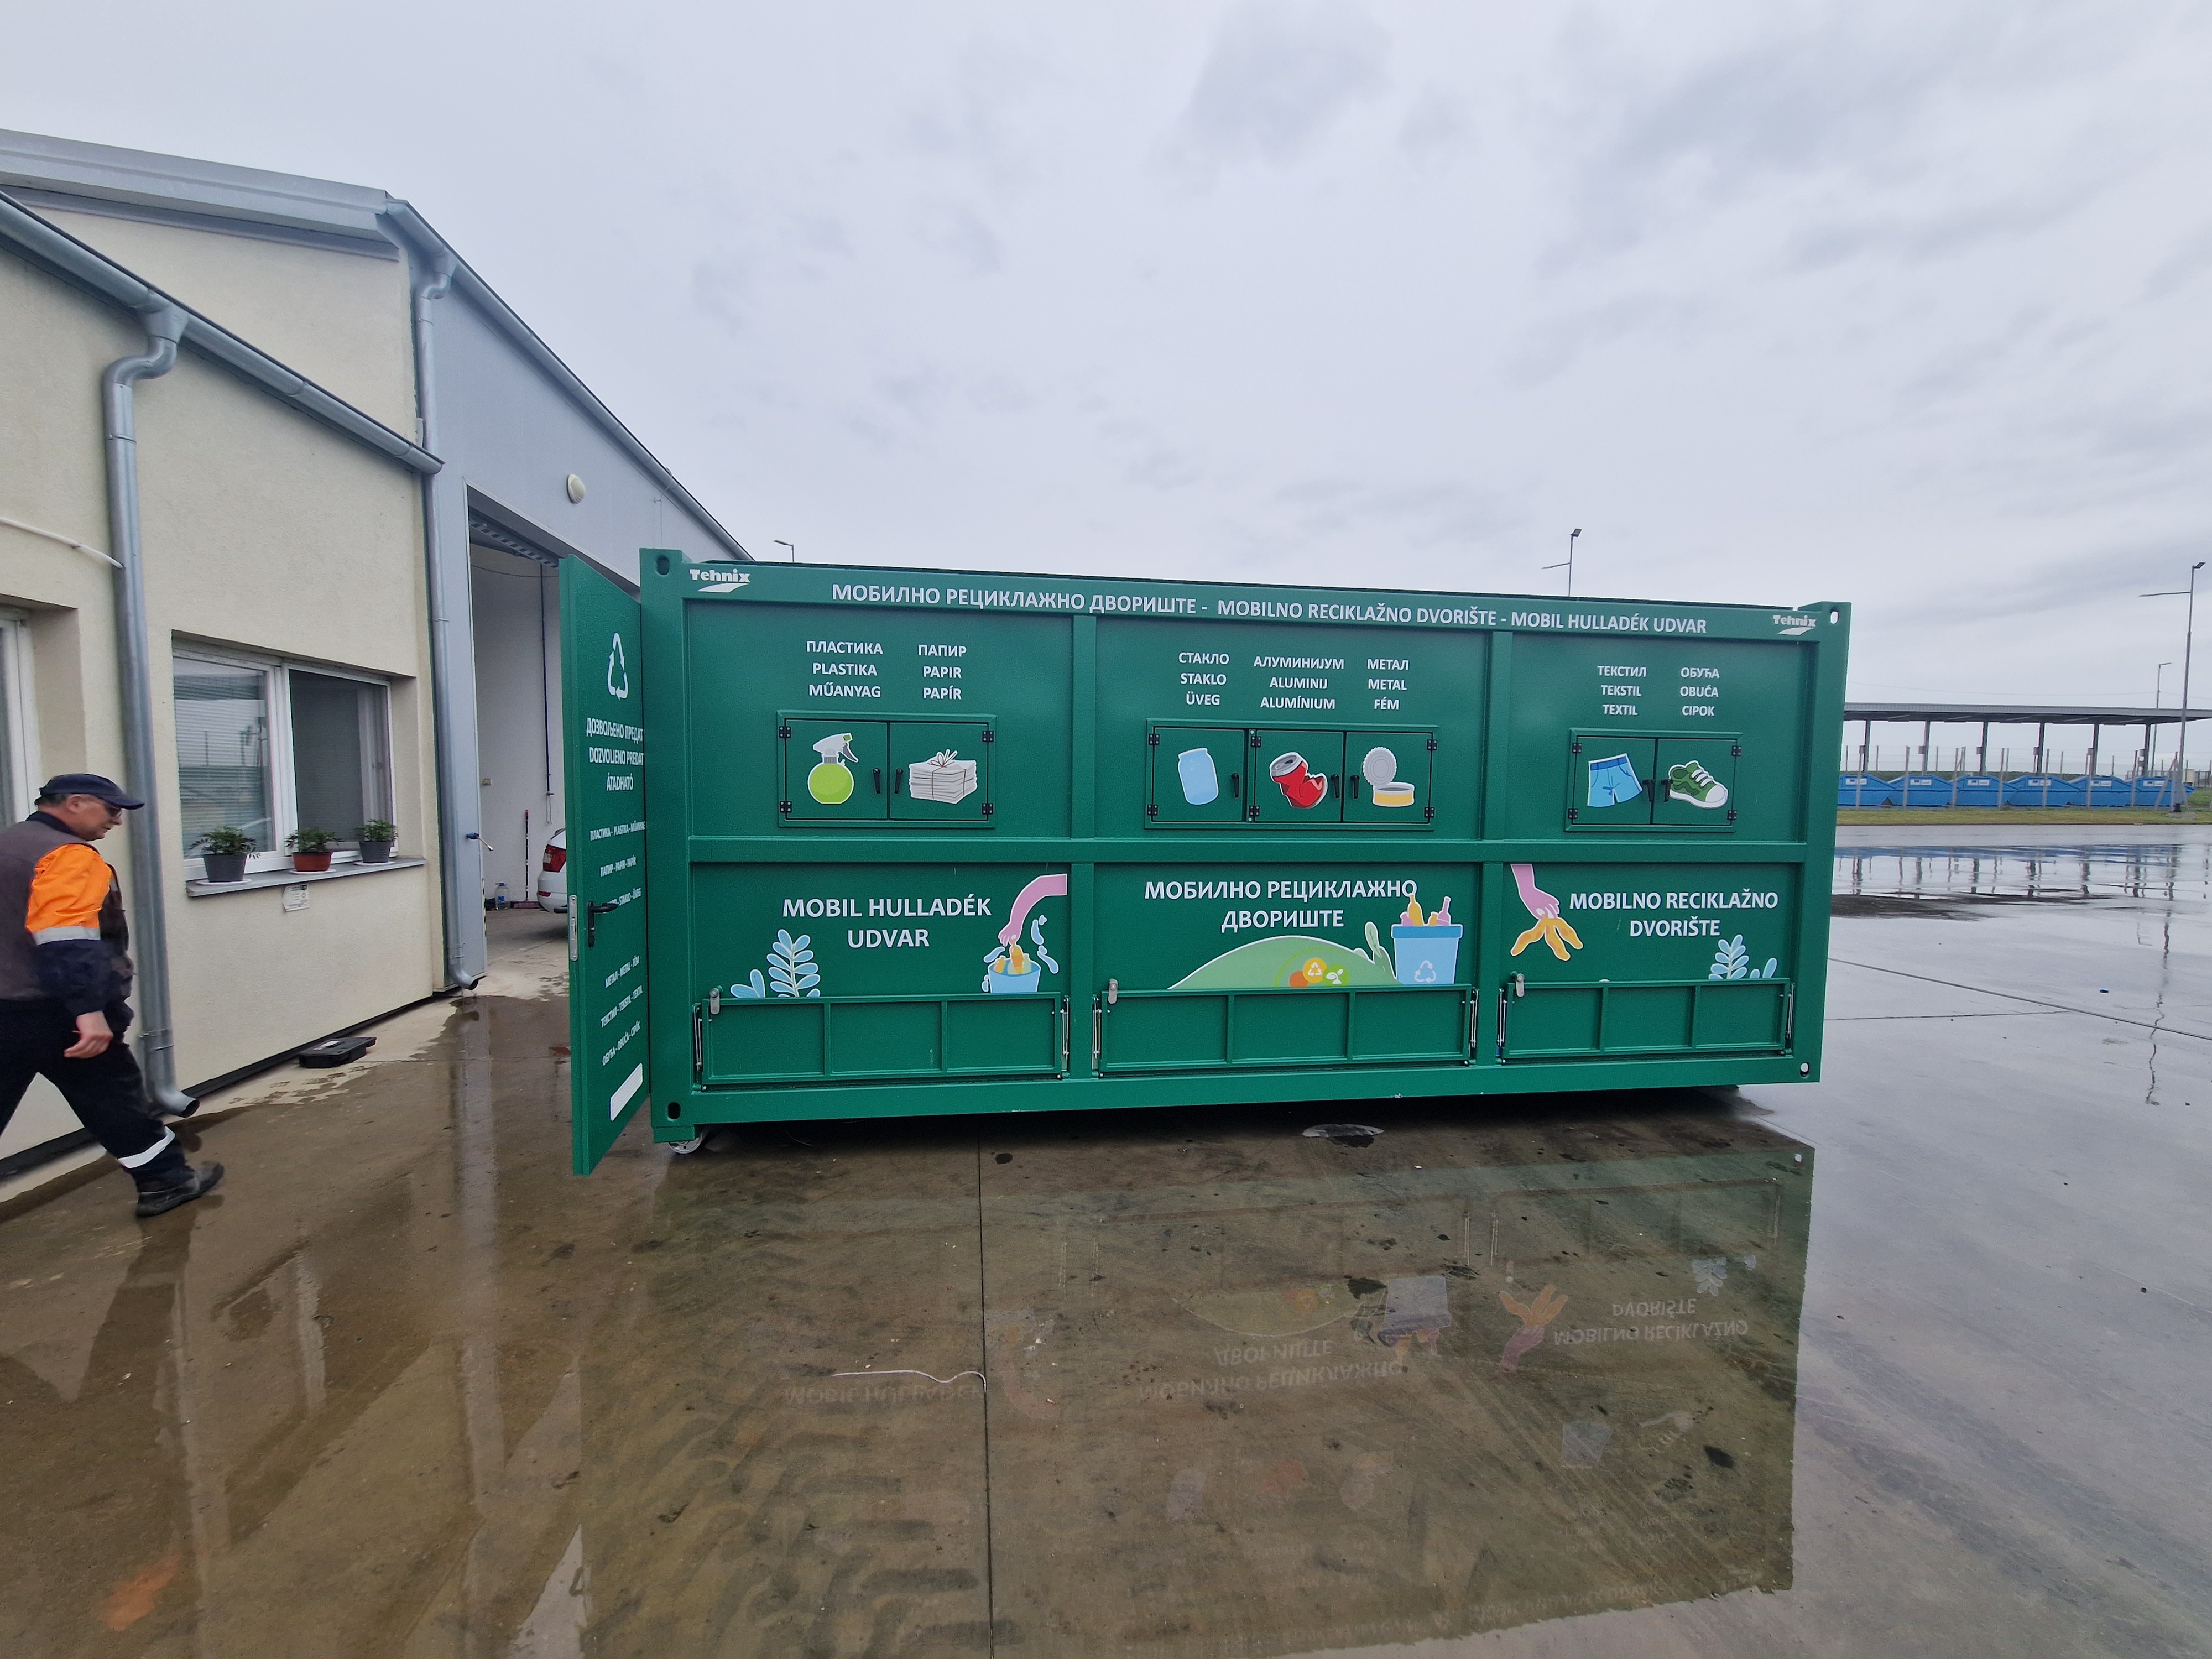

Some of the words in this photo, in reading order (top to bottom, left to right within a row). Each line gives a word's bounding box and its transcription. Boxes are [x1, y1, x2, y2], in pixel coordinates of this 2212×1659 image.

[689, 568, 750, 583] Tehnix
[832, 584, 940, 604] МОБИЛНО
[947, 588, 1085, 609] РЕЦИКЛАЖНО
[1089, 594, 1196, 614] ДВОРИШТЕ
[1218, 599, 1303, 618] MOBILNO
[1308, 602, 1412, 623] RECIKLAŽNO
[1417, 606, 1497, 625] DVORIŠTE
[1511, 612, 1564, 628] MOBIL
[1568, 613, 1650, 631] HULLADÉK
[1653, 617, 1707, 634] UDVAR
[1772, 614, 1817, 627] Tehnix
[806, 640, 884, 655] ПЛАСТИКА
[918, 644, 967, 657] ПАПИР
[1178, 652, 1229, 665] СТАКЛО
[1253, 656, 1344, 670] АЛУМИНИЈУМ
[1367, 659, 1409, 671] МЕТАЛ
[813, 662, 878, 676] PLASTIKA
[923, 666, 962, 679] PAPIR
[1597, 665, 1647, 677] ТЕКСТИЛ
[1681, 667, 1720, 679] ОБУЋА
[1180, 672, 1227, 685] STAKLO
[1269, 677, 1328, 689] ALUMINIJ
[1368, 679, 1407, 691] METAL
[809, 681, 881, 698] MŰANYAG
[923, 685, 962, 700] PAPÍR
[1600, 685, 1642, 696] TEKSTIL
[1679, 684, 1719, 697] OBUĆA
[1186, 691, 1220, 706] ÜVEG
[1260, 695, 1335, 709] ALUMÍNIUM
[1374, 696, 1399, 710] FÉM
[1602, 704, 1638, 716] TEXTIL
[1682, 705, 1715, 716] CIPOK
[586, 717, 624, 738] ДОЗВОЉЕНО
[589, 747, 626, 764] DOZVOLJENO
[606, 772, 634, 791] ÁTADHATÓ
[1145, 881, 1261, 899] МОБИЛНО
[1267, 880, 1418, 903] РЕЦИКЛАЖНО
[782, 899, 863, 917] MOBIL
[869, 893, 992, 917] HULLADÉK
[1569, 892, 1661, 910] MOBILNO
[1666, 888, 1778, 909] RECIKLAŽNO
[1221, 910, 1344, 933] ДВОРИШТЕ
[1630, 916, 1720, 937] DVORIŠTE
[848, 929, 930, 948] UDVAR
